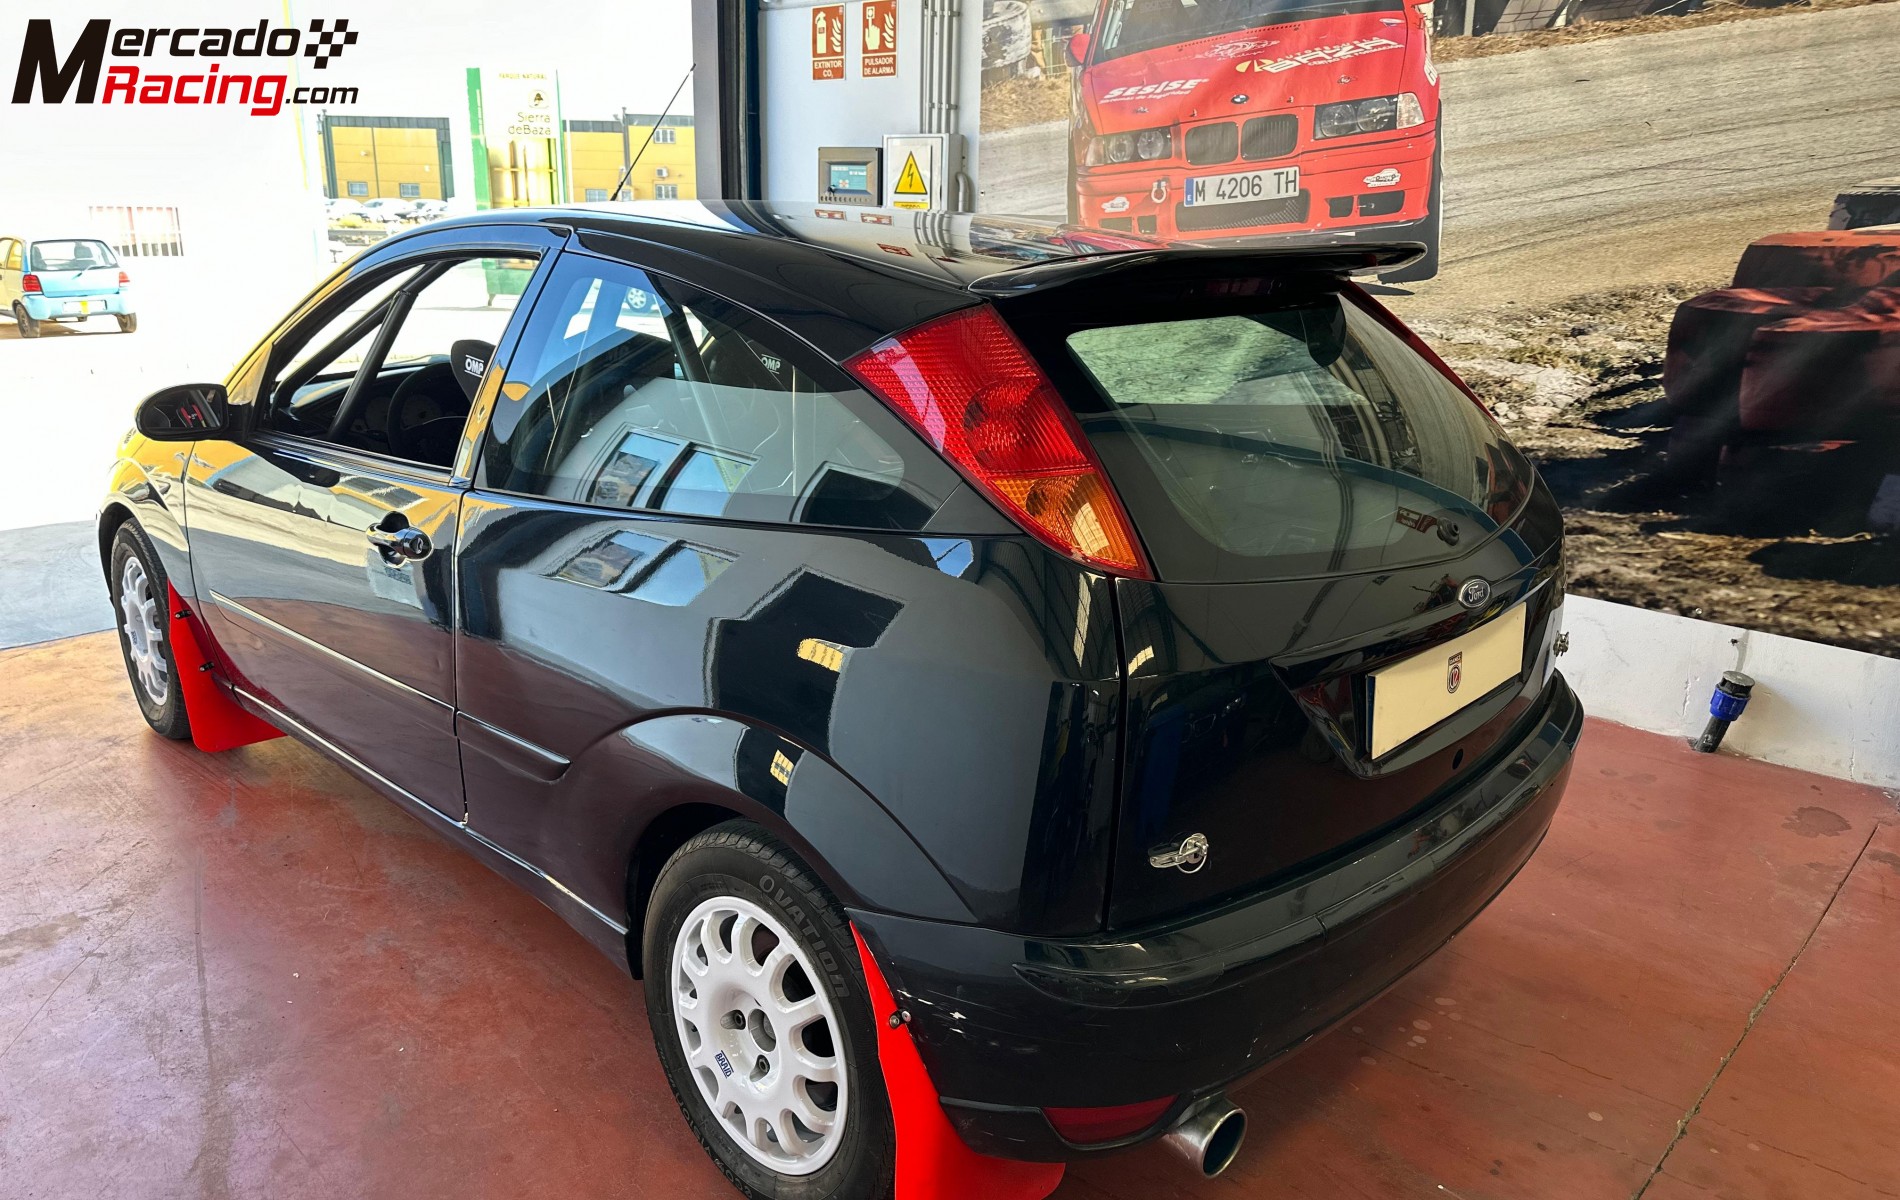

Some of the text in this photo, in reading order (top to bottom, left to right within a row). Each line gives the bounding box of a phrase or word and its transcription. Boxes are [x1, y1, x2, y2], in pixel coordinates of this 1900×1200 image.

[814, 60, 843, 69] EXTINTOR
[864, 56, 894, 66] PULSADOR
[864, 65, 894, 75] DE ALARMA
[517, 112, 551, 123] Sierra
[1195, 169, 1298, 202] M 4206 TH
[465, 357, 484, 375] OMP
[761, 356, 781, 371] OMP
[1467, 584, 1485, 603] Ford
[714, 1051, 733, 1078] BRAID
